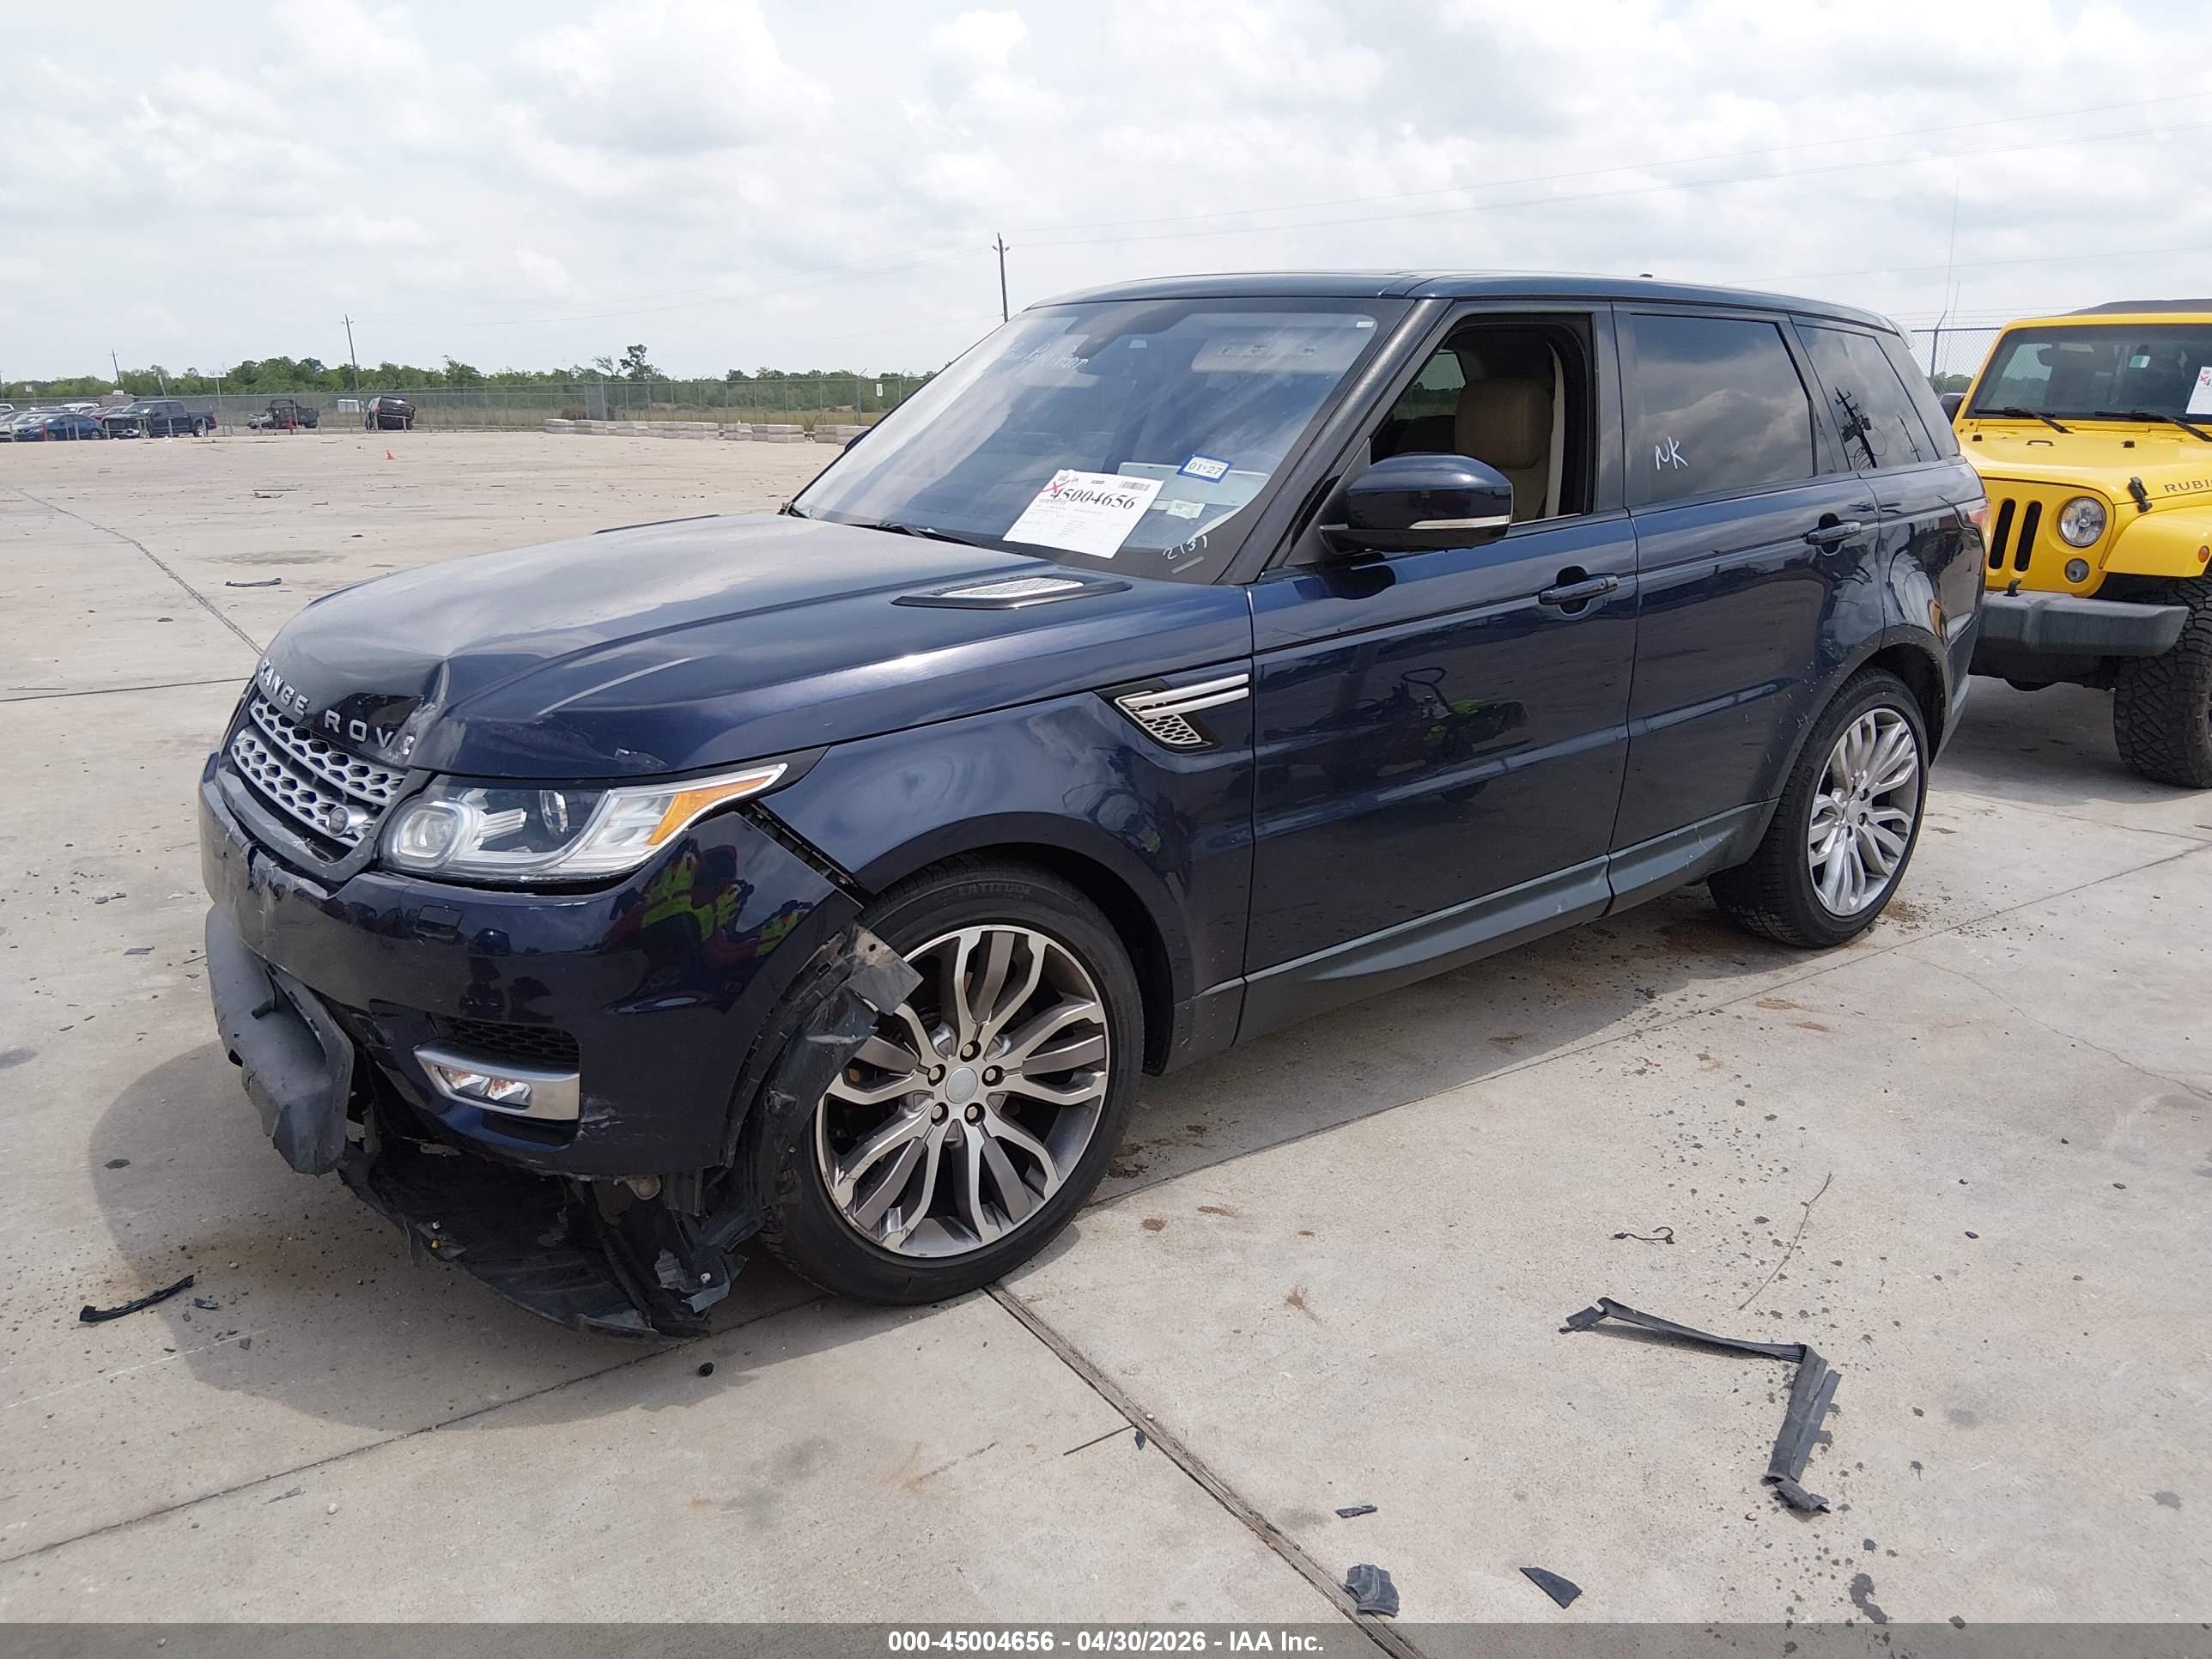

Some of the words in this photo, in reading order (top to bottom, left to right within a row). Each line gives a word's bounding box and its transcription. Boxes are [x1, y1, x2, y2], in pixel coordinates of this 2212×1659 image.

[2163, 479, 2212, 493] RUBI
[1051, 487, 1139, 509] 45004656
[260, 658, 310, 716] RANGE
[957, 883, 1031, 895] LATITUDE
